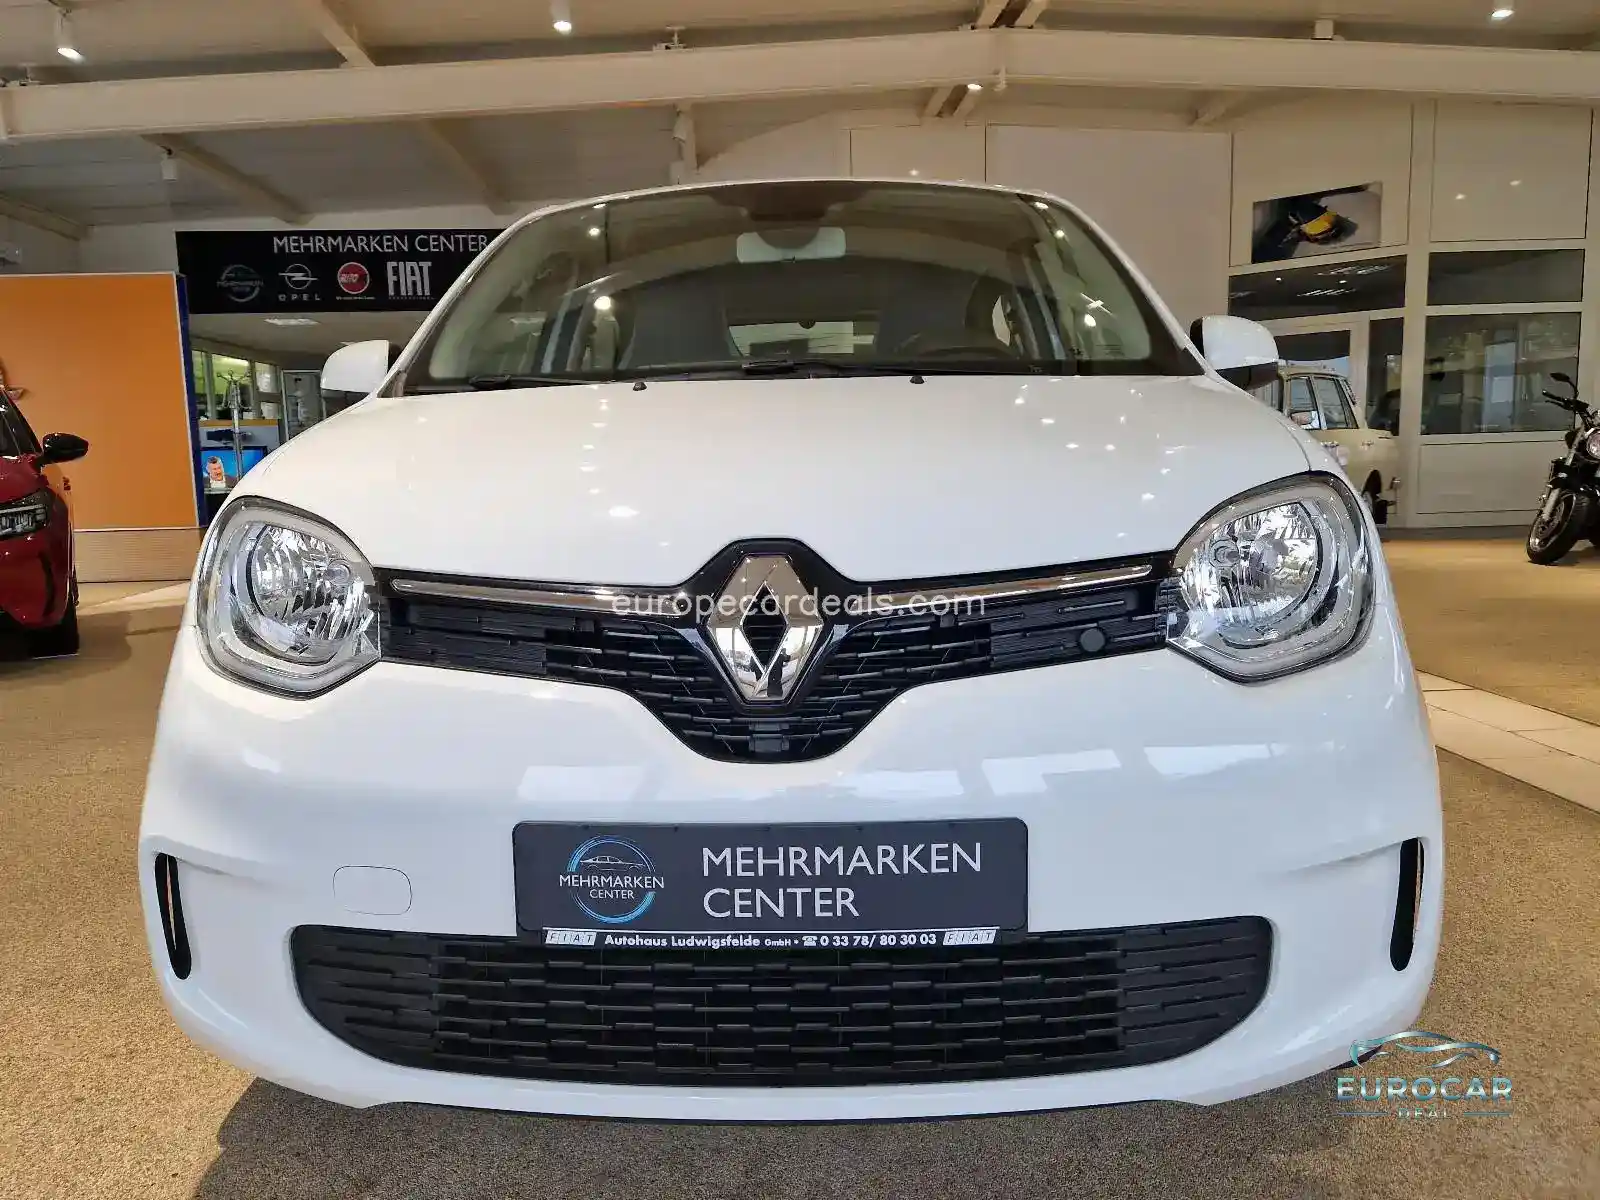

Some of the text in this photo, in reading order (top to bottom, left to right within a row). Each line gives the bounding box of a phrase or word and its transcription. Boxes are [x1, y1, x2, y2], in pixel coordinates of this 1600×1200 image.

[273, 234, 488, 253] MEHRMARKEN CENTER
[387, 261, 432, 296] FIAT
[278, 293, 321, 301] OPEL
[702, 842, 981, 877] MEHRMARKEN
[559, 874, 665, 889] MEHRMARKEN
[589, 889, 635, 900] CENTER
[703, 887, 859, 918] CENTER
[546, 931, 596, 946] FIAT
[604, 935, 668, 947] Autohaus
[671, 935, 761, 949] Ludwigsfelde
[764, 938, 792, 947] GmbH
[832, 935, 849, 947] 33
[900, 934, 917, 945] 30
[919, 934, 937, 945] 03
[943, 929, 997, 945] FIAT
